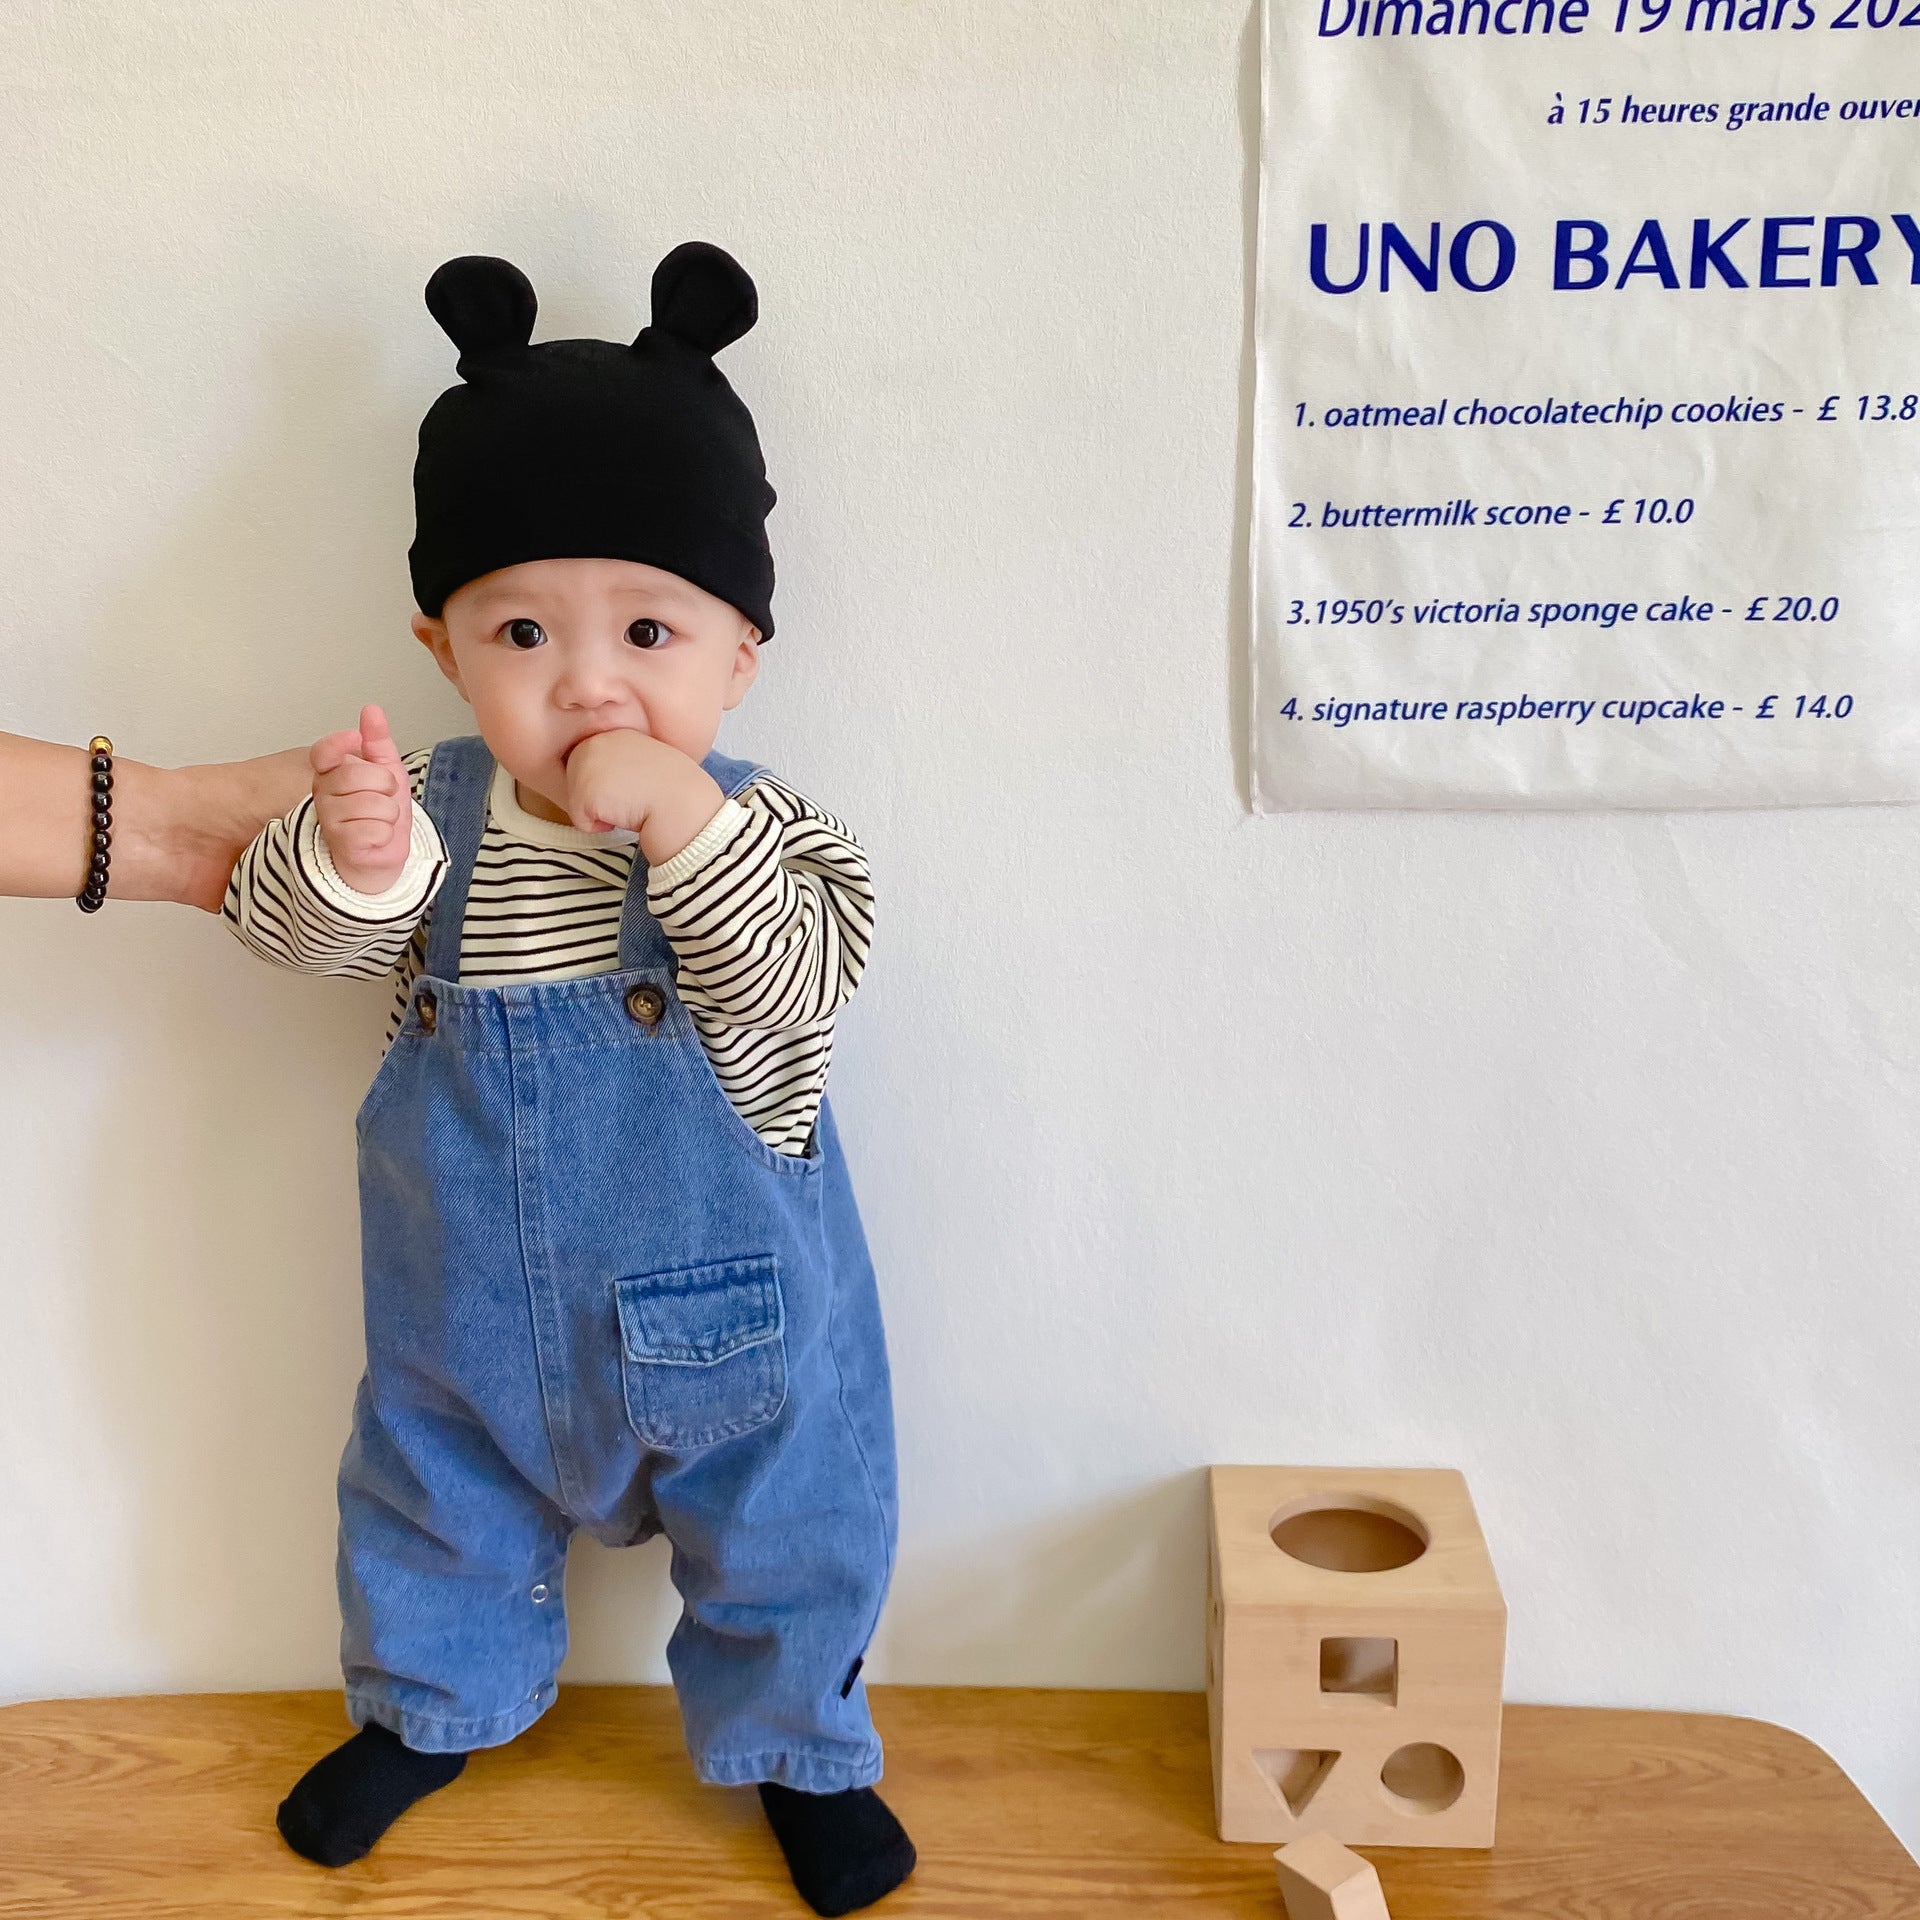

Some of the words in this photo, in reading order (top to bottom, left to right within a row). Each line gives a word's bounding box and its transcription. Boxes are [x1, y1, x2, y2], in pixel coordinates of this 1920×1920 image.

[1318, 0, 1589, 37] Dimanche
[1614, 0, 1672, 33] 19
[1684, 0, 1816, 32] mars
[1548, 92, 1564, 125] à
[1578, 98, 1610, 123] 15
[1622, 95, 1718, 123] heures
[1728, 92, 1830, 130] grande
[1309, 220, 1517, 295] UNO
[1552, 213, 1920, 291] BAKERY
[1295, 403, 1315, 426] 1.
[1324, 398, 1447, 427] oatmeal
[1453, 397, 1664, 430] chocolatechip
[1671, 395, 1784, 424] cookies
[1816, 396, 1839, 421] £
[1856, 394, 1919, 421] 13.8
[1288, 503, 1313, 528] 2.
[1321, 500, 1477, 528] buttermilk
[1483, 504, 1573, 526] scone
[1601, 499, 1624, 524] £
[1632, 498, 1695, 525] 10.0
[1413, 600, 1521, 625] victoria
[1527, 602, 1638, 630] sponge
[1645, 596, 1714, 622] cake
[1772, 596, 1840, 623] 20.0
[1280, 697, 1304, 721] 4.
[1312, 697, 1449, 728] signature
[1456, 694, 1596, 727] raspberry
[1601, 694, 1726, 726] cupcake
[1755, 694, 1777, 720] £
[1793, 694, 1854, 719] 14.0
